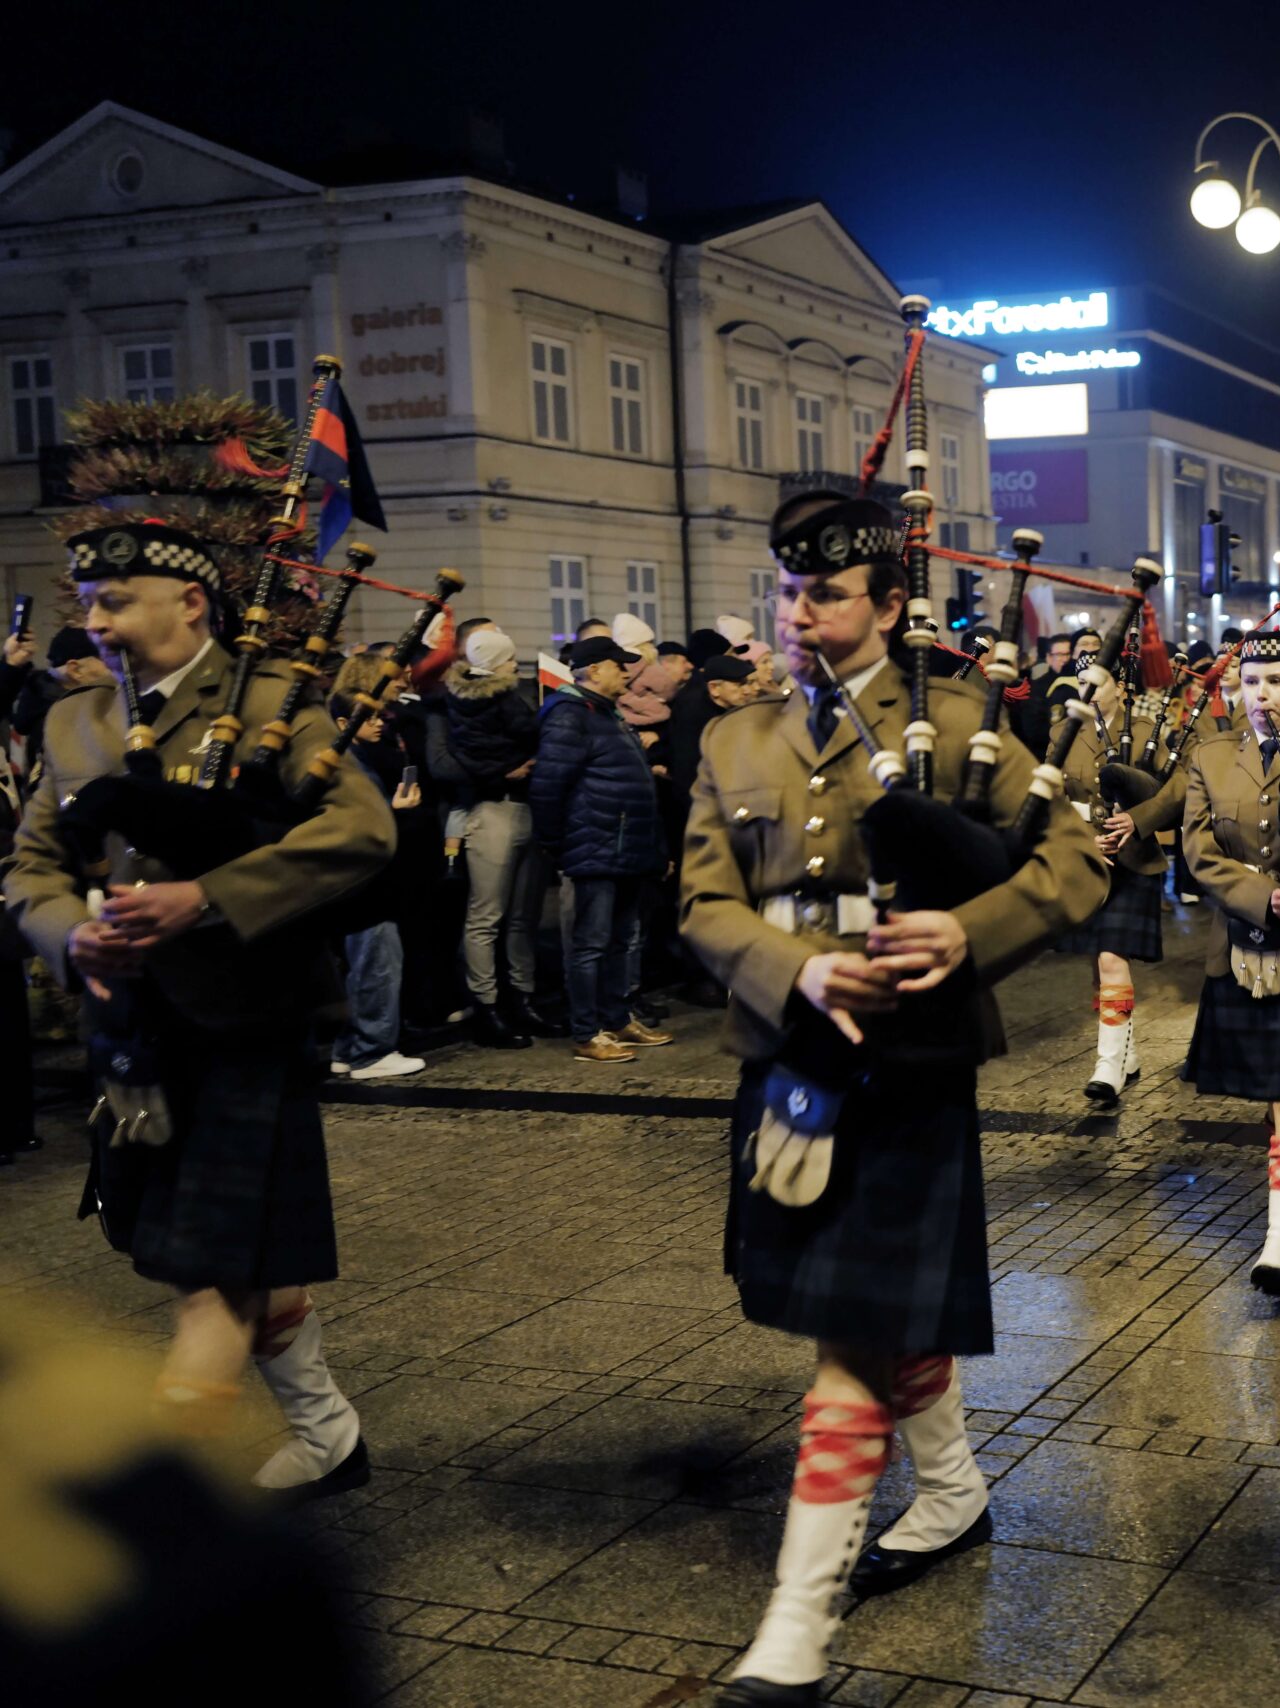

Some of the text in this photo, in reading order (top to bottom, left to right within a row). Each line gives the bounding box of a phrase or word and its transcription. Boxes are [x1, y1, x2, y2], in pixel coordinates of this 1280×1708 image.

[351, 302, 443, 337] galeria
[359, 347, 446, 377] dobrej
[366, 394, 448, 422] sztuki
[991, 470, 1037, 492] RGO
